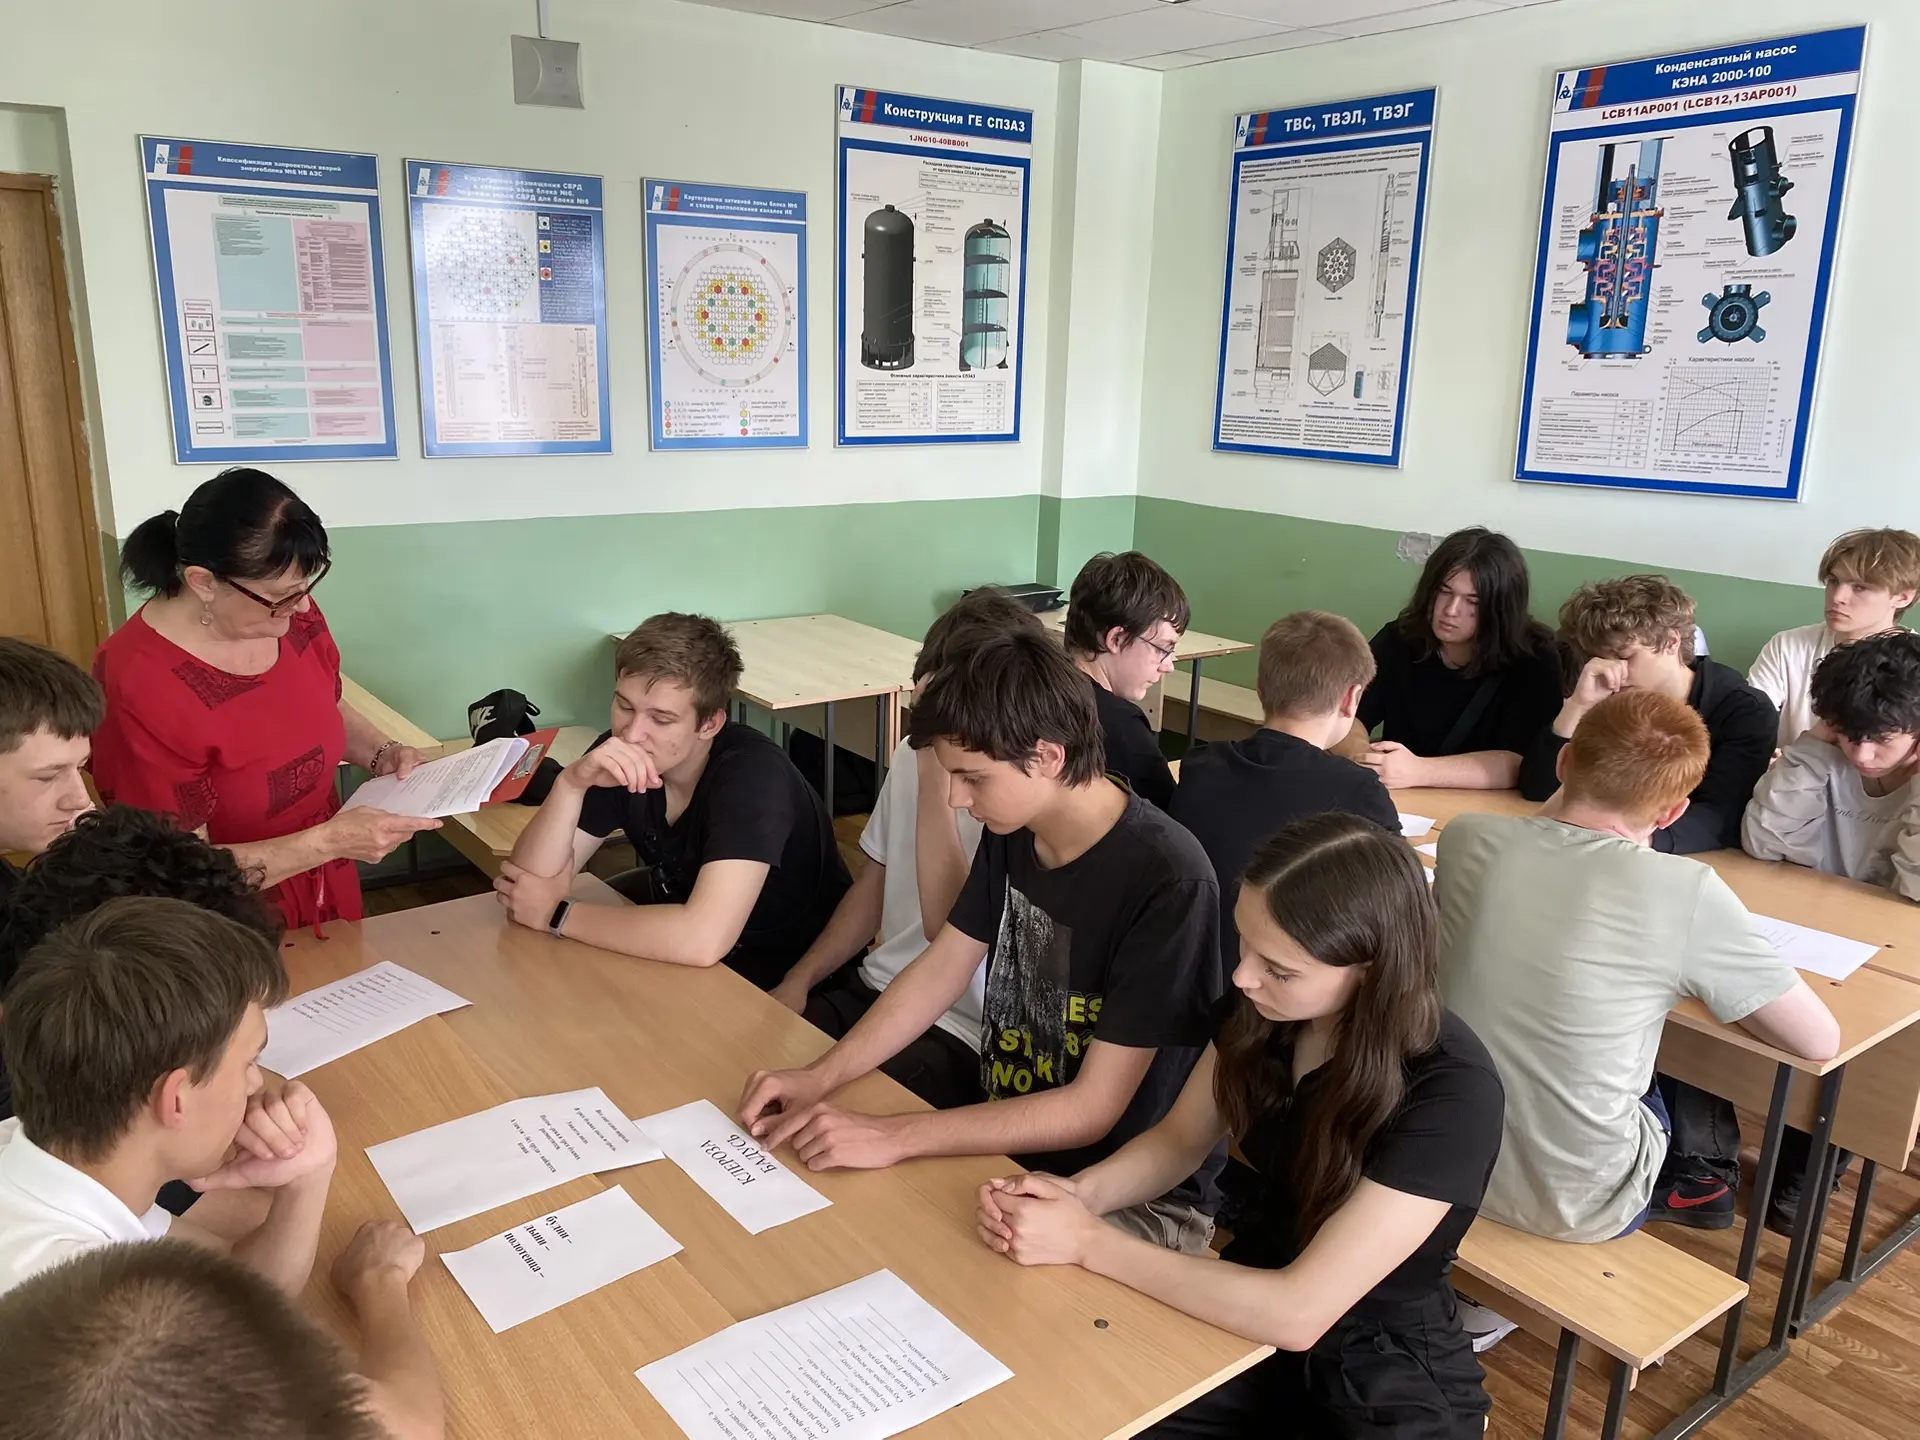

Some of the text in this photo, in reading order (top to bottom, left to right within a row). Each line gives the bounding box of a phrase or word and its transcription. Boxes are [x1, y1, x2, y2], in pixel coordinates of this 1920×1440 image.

[1655, 45, 1797, 75] Конденсатный насос
[1672, 65, 1772, 89] КЭНА 2000-100
[884, 103, 1025, 132] Конструкция ГЕ СПЗАЗ
[1284, 102, 1414, 132] ТВС, ТВЭЛ, ТВЭГ
[1602, 85, 1797, 120] LCB11AP001 (LCB12,13AP001)
[218, 156, 272, 166] Классификация
[700, 1140, 756, 1185] КЛЕРОЗА
[727, 1134, 777, 1173] БАДУСЬ
[523, 1224, 547, 1245] дыни
[545, 1216, 569, 1239] будни
[504, 1232, 541, 1273] полотенца
